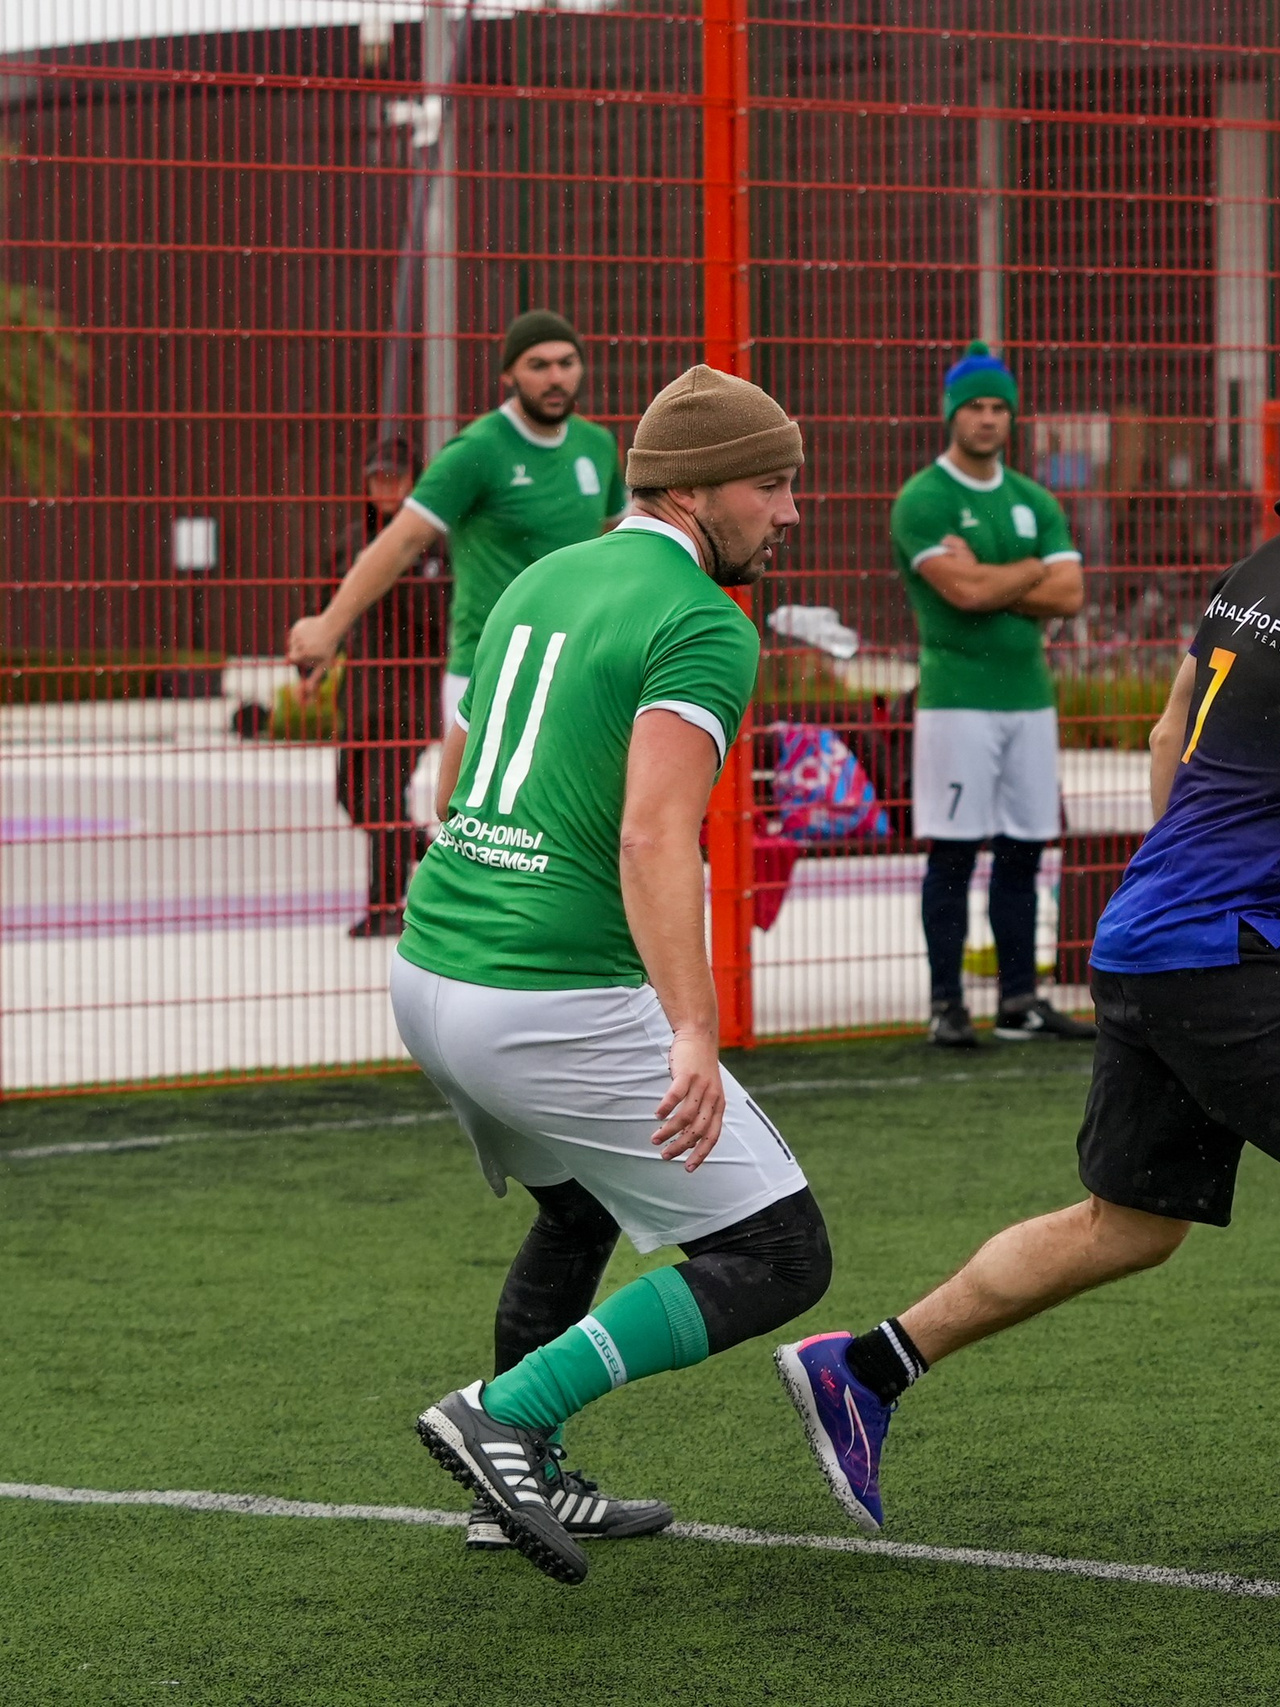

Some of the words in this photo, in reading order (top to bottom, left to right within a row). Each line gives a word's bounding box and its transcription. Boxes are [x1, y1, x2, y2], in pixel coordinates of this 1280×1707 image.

[466, 624, 567, 815] 11
[1181, 646, 1237, 764] 7
[949, 782, 963, 820] 7
[435, 823, 549, 873] ЕРНОЗЕМЬЯ
[447, 812, 544, 850] РОНОМЫ
